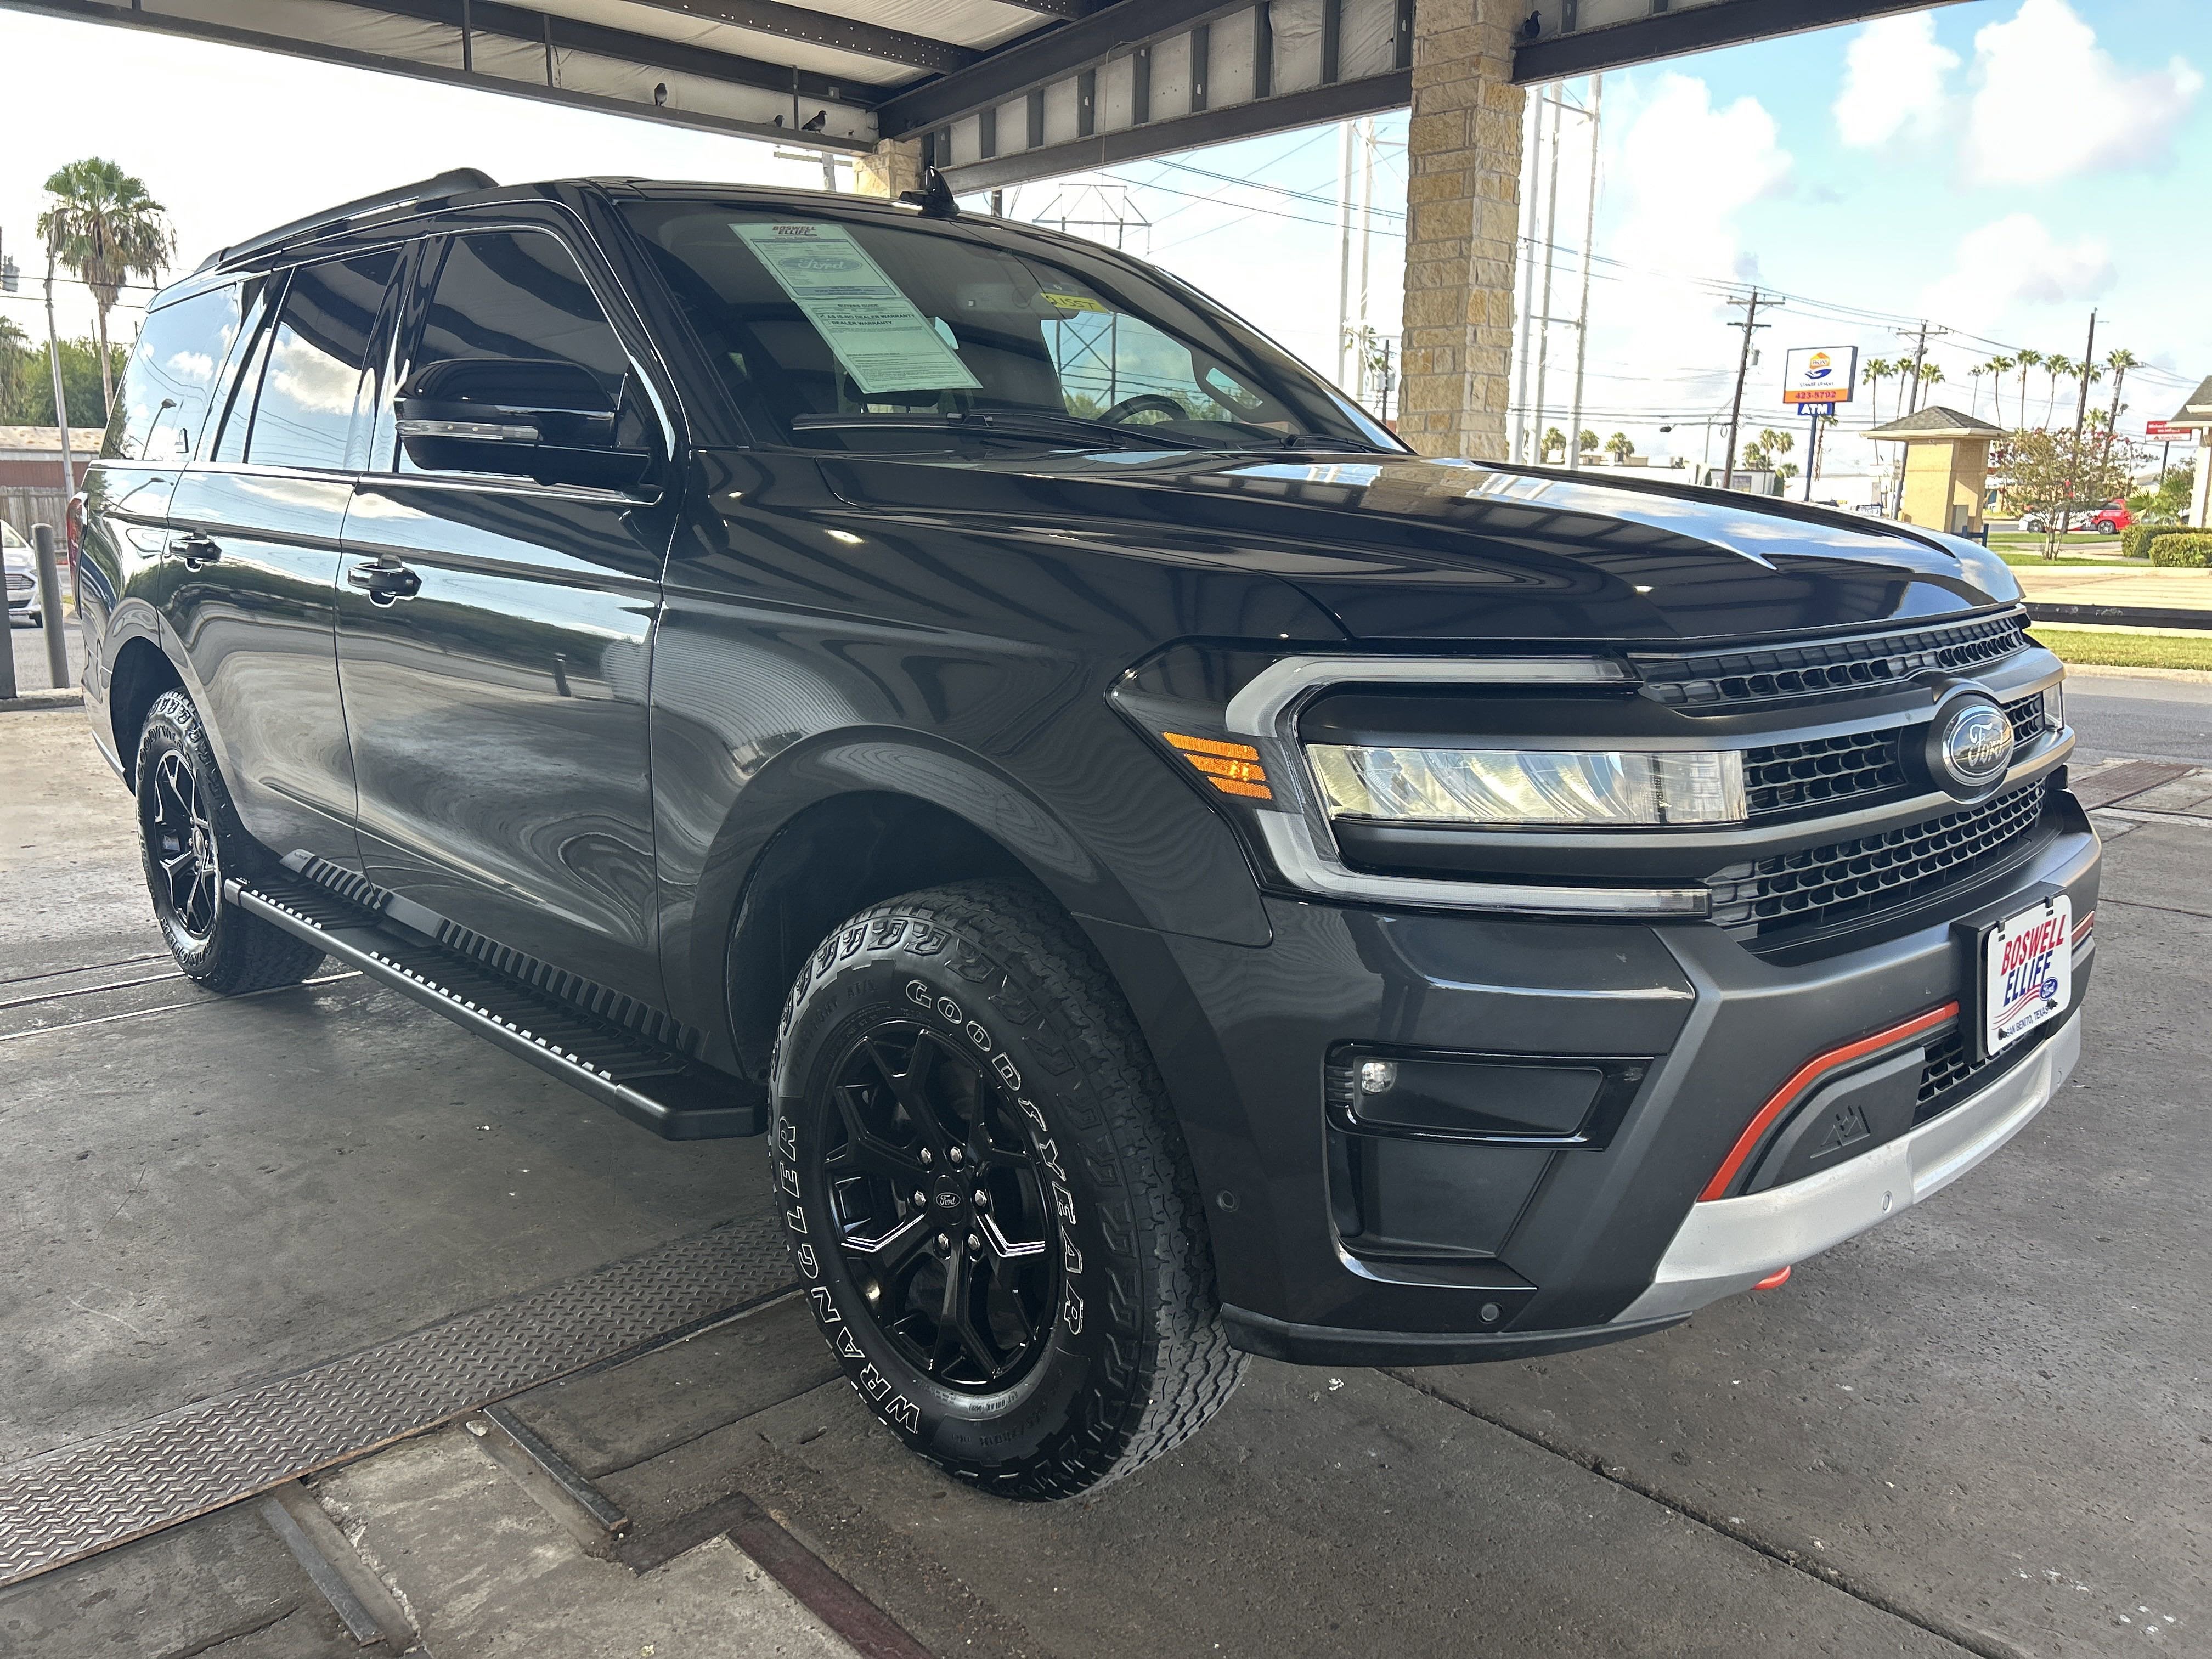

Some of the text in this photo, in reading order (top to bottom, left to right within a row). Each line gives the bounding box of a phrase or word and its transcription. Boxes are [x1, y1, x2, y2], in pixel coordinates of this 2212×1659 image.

[798, 258, 847, 270] Ford
[1801, 404, 1828, 415] ATM
[1967, 721, 2004, 767] Ford
[2000, 914, 2067, 977] BOSWELL
[2002, 949, 2054, 1007] ELLIFF
[2006, 1024, 2016, 1037] SAN
[2033, 1006, 2050, 1020] TEXAS
[906, 979, 1084, 1336] GOODYEAR
[940, 1194, 956, 1205] Ford
[780, 1115, 921, 1435] WRANGLER
